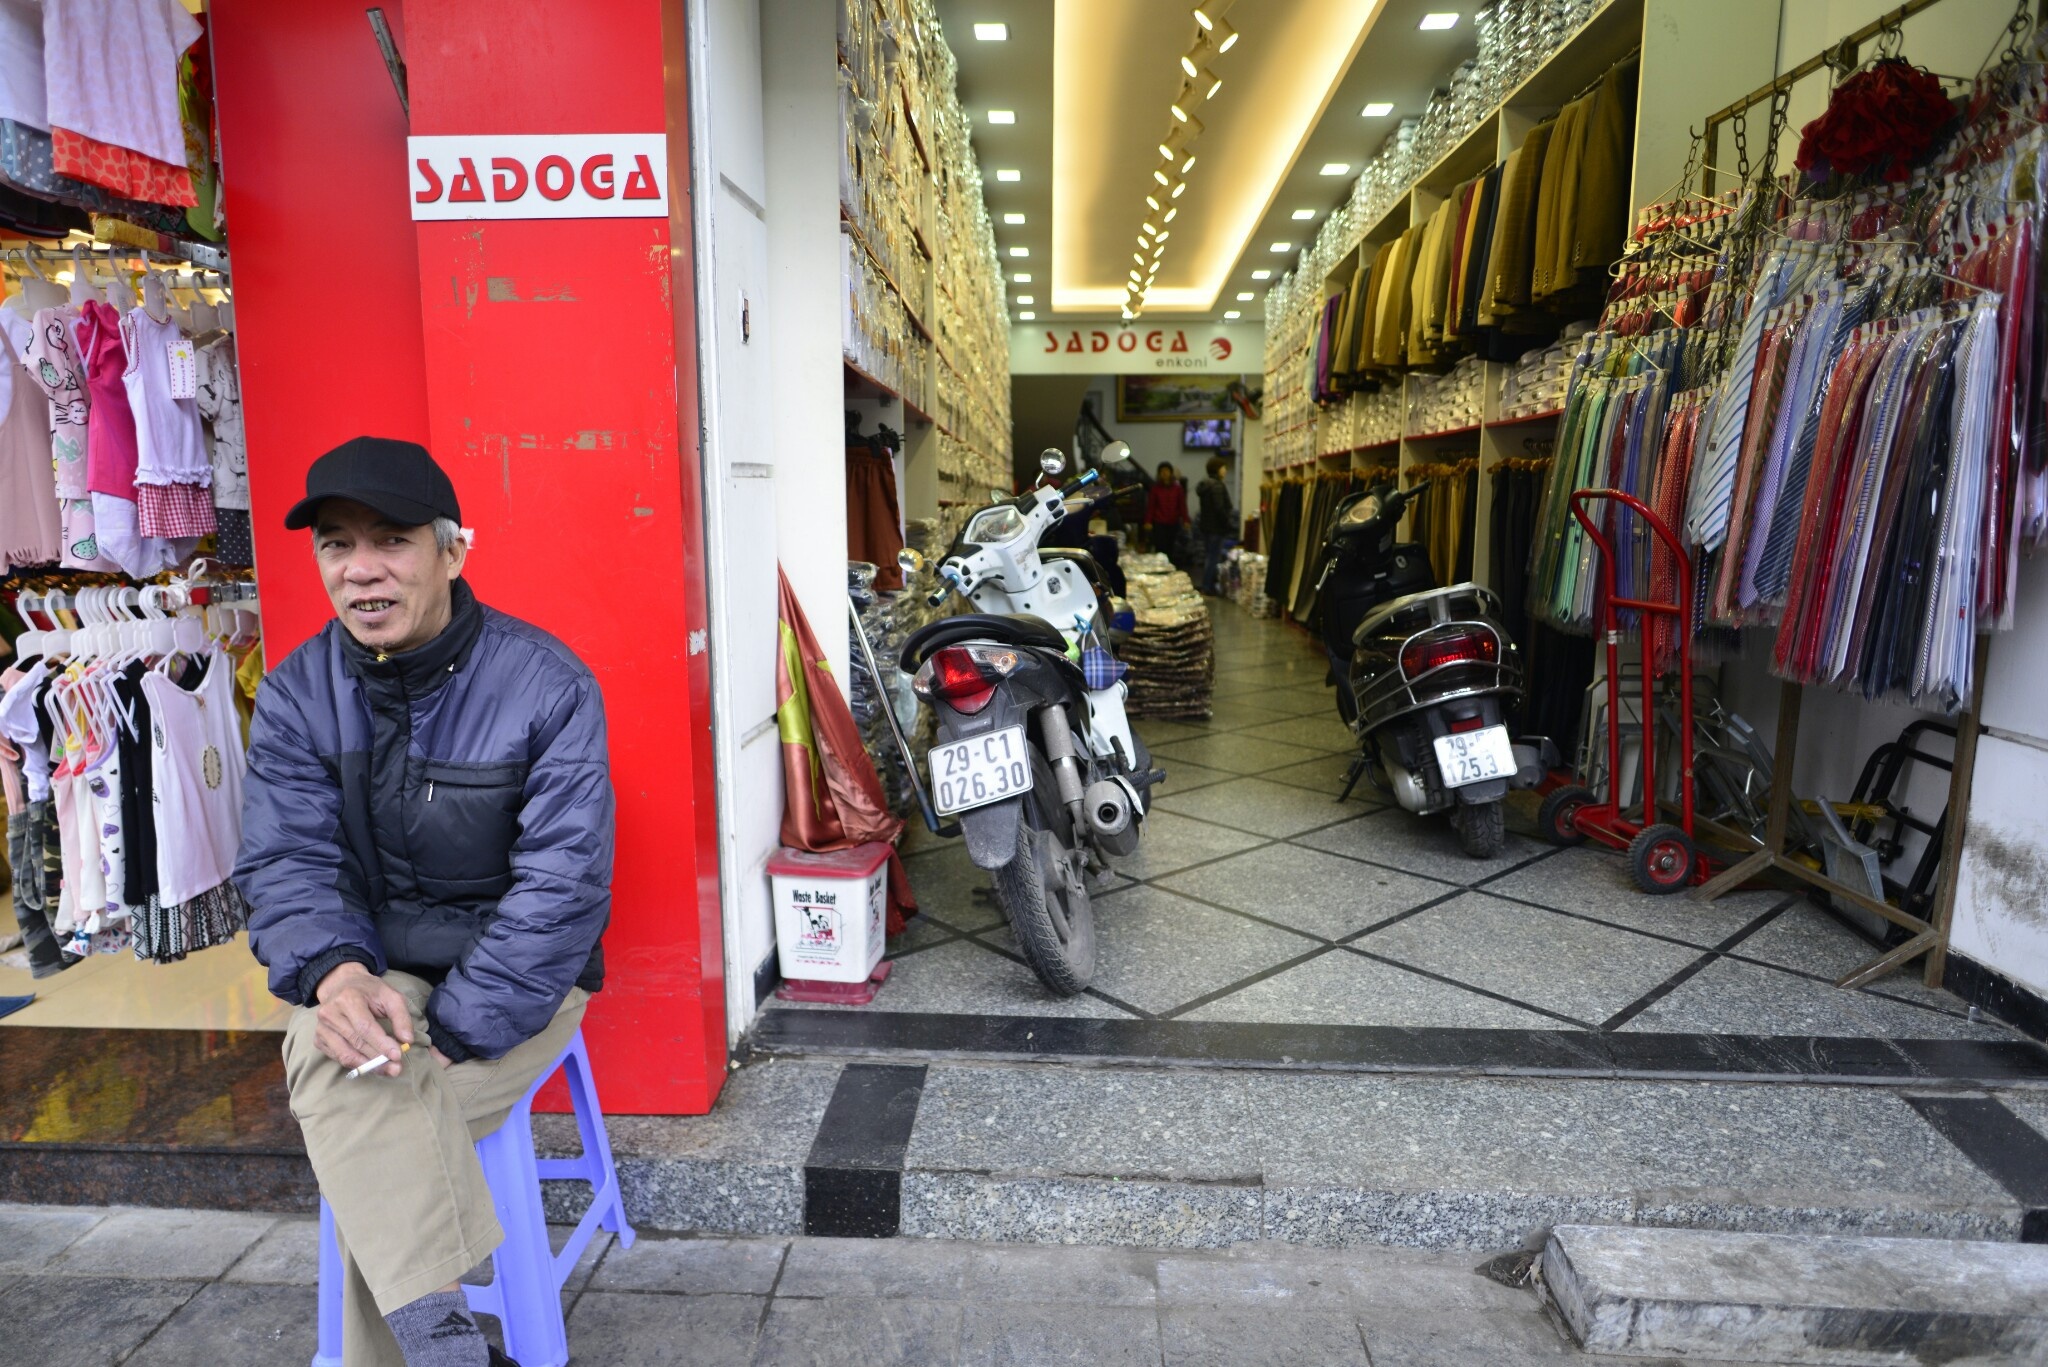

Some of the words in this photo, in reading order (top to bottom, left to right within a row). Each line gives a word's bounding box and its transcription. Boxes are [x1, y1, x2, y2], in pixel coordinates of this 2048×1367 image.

[415, 154, 661, 203] SADOGA
[1044, 330, 1189, 353] SADOGA
[1155, 356, 1208, 369] enkoni
[943, 733, 1012, 777] 29-C1
[940, 762, 1026, 809] 026.30
[792, 889, 812, 904] Waste
[815, 890, 837, 906] Basket
